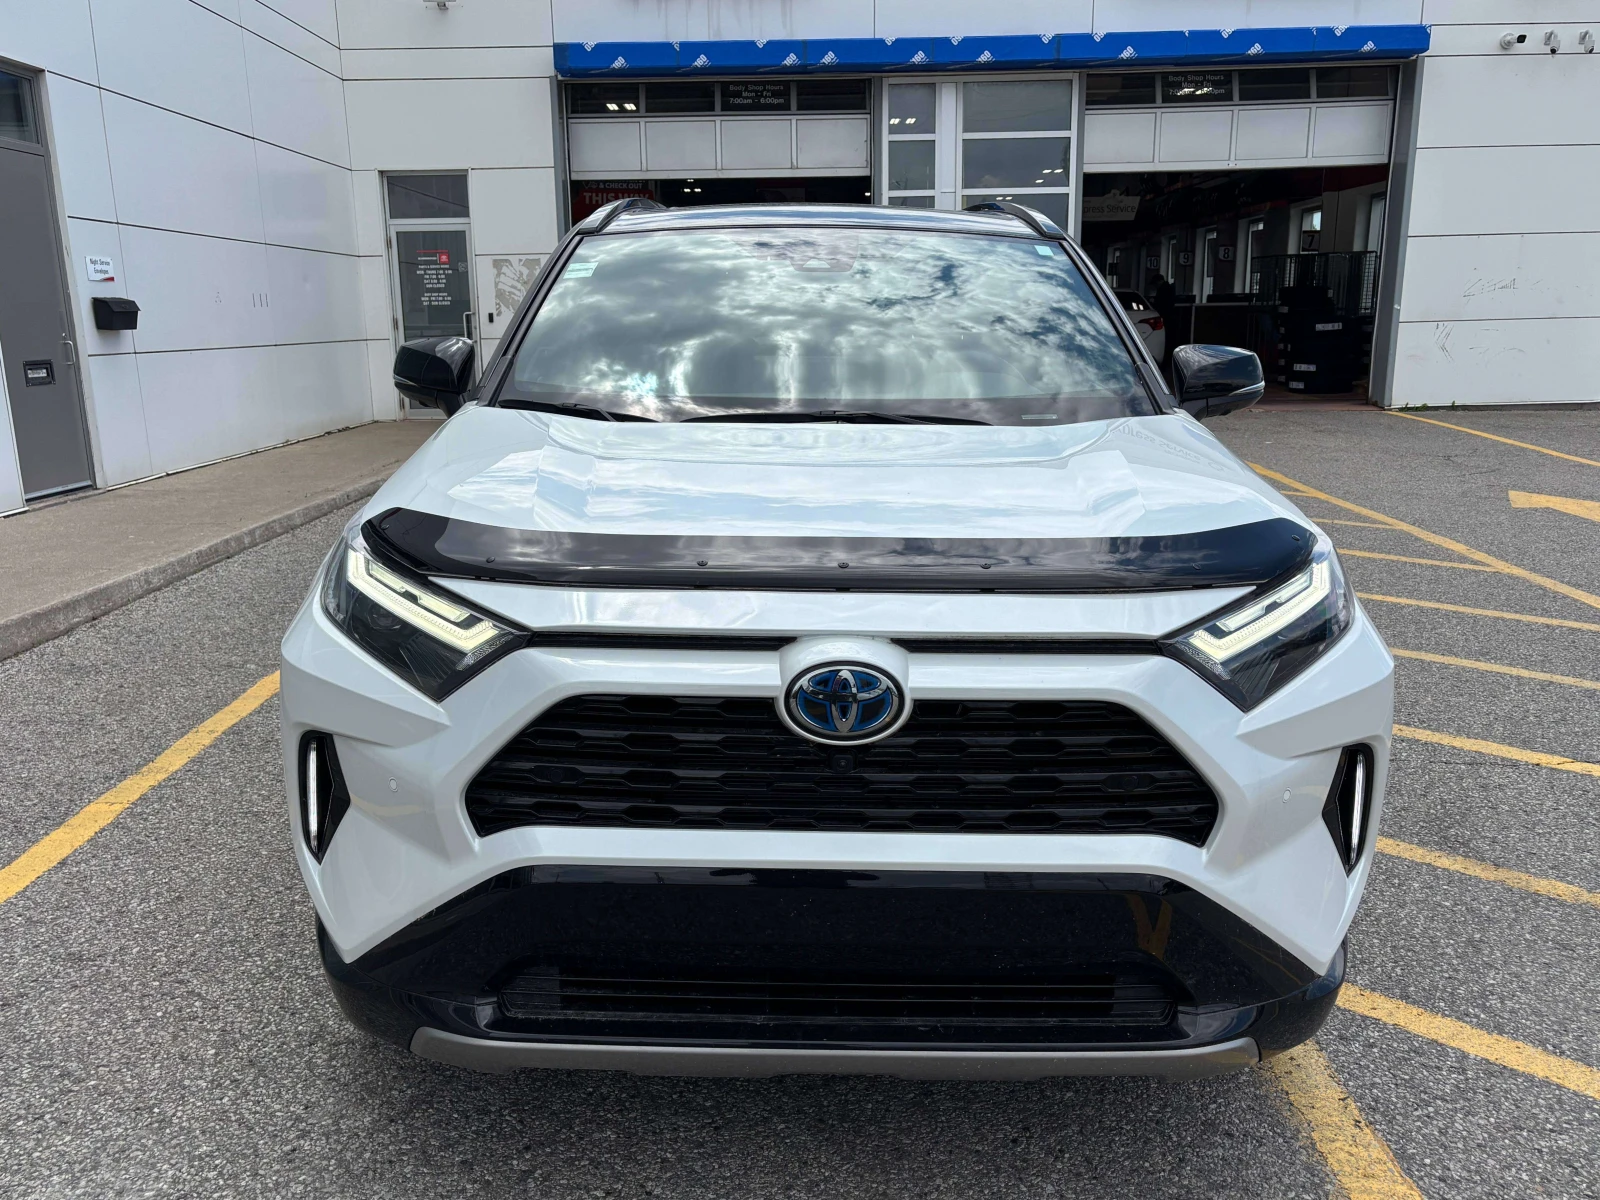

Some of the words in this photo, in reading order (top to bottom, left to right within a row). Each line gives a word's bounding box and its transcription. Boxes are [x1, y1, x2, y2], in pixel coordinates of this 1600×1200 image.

[584, 193, 616, 205] THIS
[1106, 204, 1136, 213] Service
[1308, 235, 1315, 248] 7
[1223, 248, 1230, 259] 8
[90, 258, 99, 266] Night
[1147, 258, 1158, 267] 10
[1183, 254, 1189, 263] 9
